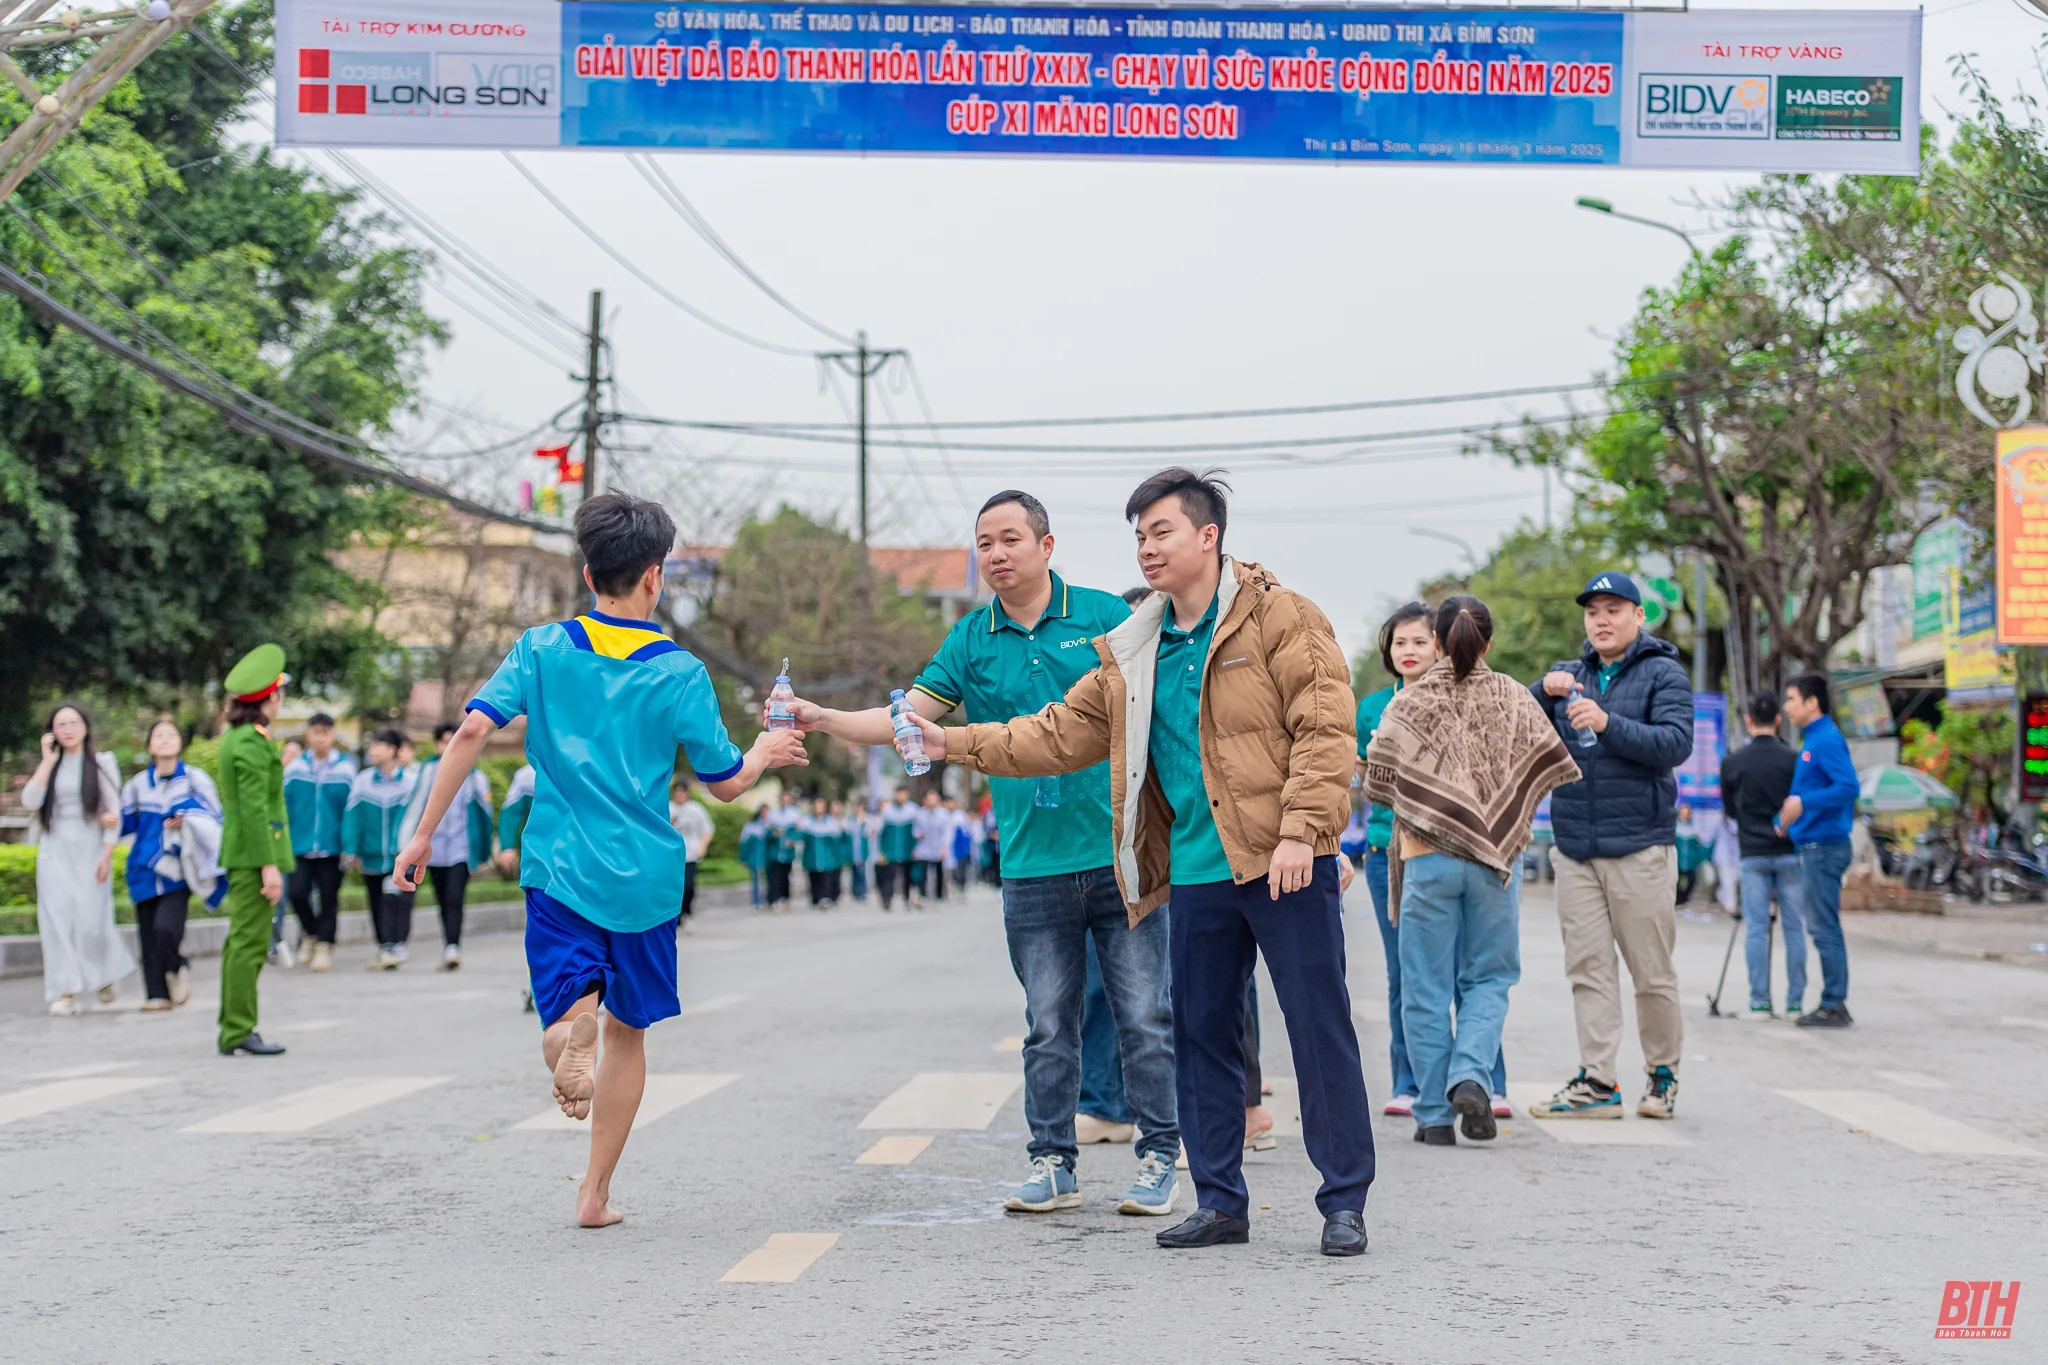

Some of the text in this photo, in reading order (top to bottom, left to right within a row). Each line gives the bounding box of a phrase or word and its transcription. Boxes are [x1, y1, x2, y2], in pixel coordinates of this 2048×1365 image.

[321, 17, 350, 33] TÀI
[358, 22, 401, 38] TRỢ
[406, 23, 442, 35] KIM
[653, 8, 680, 29] SỞ
[683, 10, 719, 30] VĂN
[807, 14, 852, 32] THAO
[857, 11, 880, 32] VÀ
[884, 15, 909, 33] DU
[913, 15, 954, 36] LỊCH
[970, 15, 1007, 35] BÁO
[1011, 17, 1070, 36] THANH
[1074, 16, 1112, 36] HÓA
[1171, 18, 1222, 39] ĐOÀN
[1226, 21, 1284, 40] THANH
[1289, 20, 1326, 41] HÓA
[1342, 24, 1391, 41] UBND
[1396, 24, 1424, 45] THỊ
[1428, 22, 1454, 42] XÃ
[1496, 26, 1536, 45] SƠN
[1702, 41, 1843, 62] TÀI TRỢ VÀNG
[576, 33, 626, 76] GIẢI
[631, 40, 683, 86] VIỆT
[688, 40, 723, 79] DÃ
[728, 39, 780, 80] BÁO
[785, 48, 864, 82] THANH
[869, 42, 921, 83] HÓA
[927, 40, 975, 84] LẦN
[981, 45, 1030, 84] THỨ
[1031, 53, 1091, 86] XXIX
[1113, 53, 1180, 95] CHẠY
[1183, 48, 1209, 88] VÌ
[1214, 49, 1264, 90] SỨC
[1269, 47, 1334, 91] KHỎE
[1340, 51, 1408, 99] CỘNG
[1413, 50, 1482, 93] ĐỒNG
[1487, 54, 1547, 95] NĂM
[1551, 61, 1613, 97] 2025
[371, 85, 548, 107] LONG SON
[1647, 84, 1734, 114] BIDV
[1785, 88, 1870, 106] HABECO
[947, 94, 1238, 138] CÚP XI MĂNG LONG SƠN
[1060, 639, 1080, 649] BIDV
